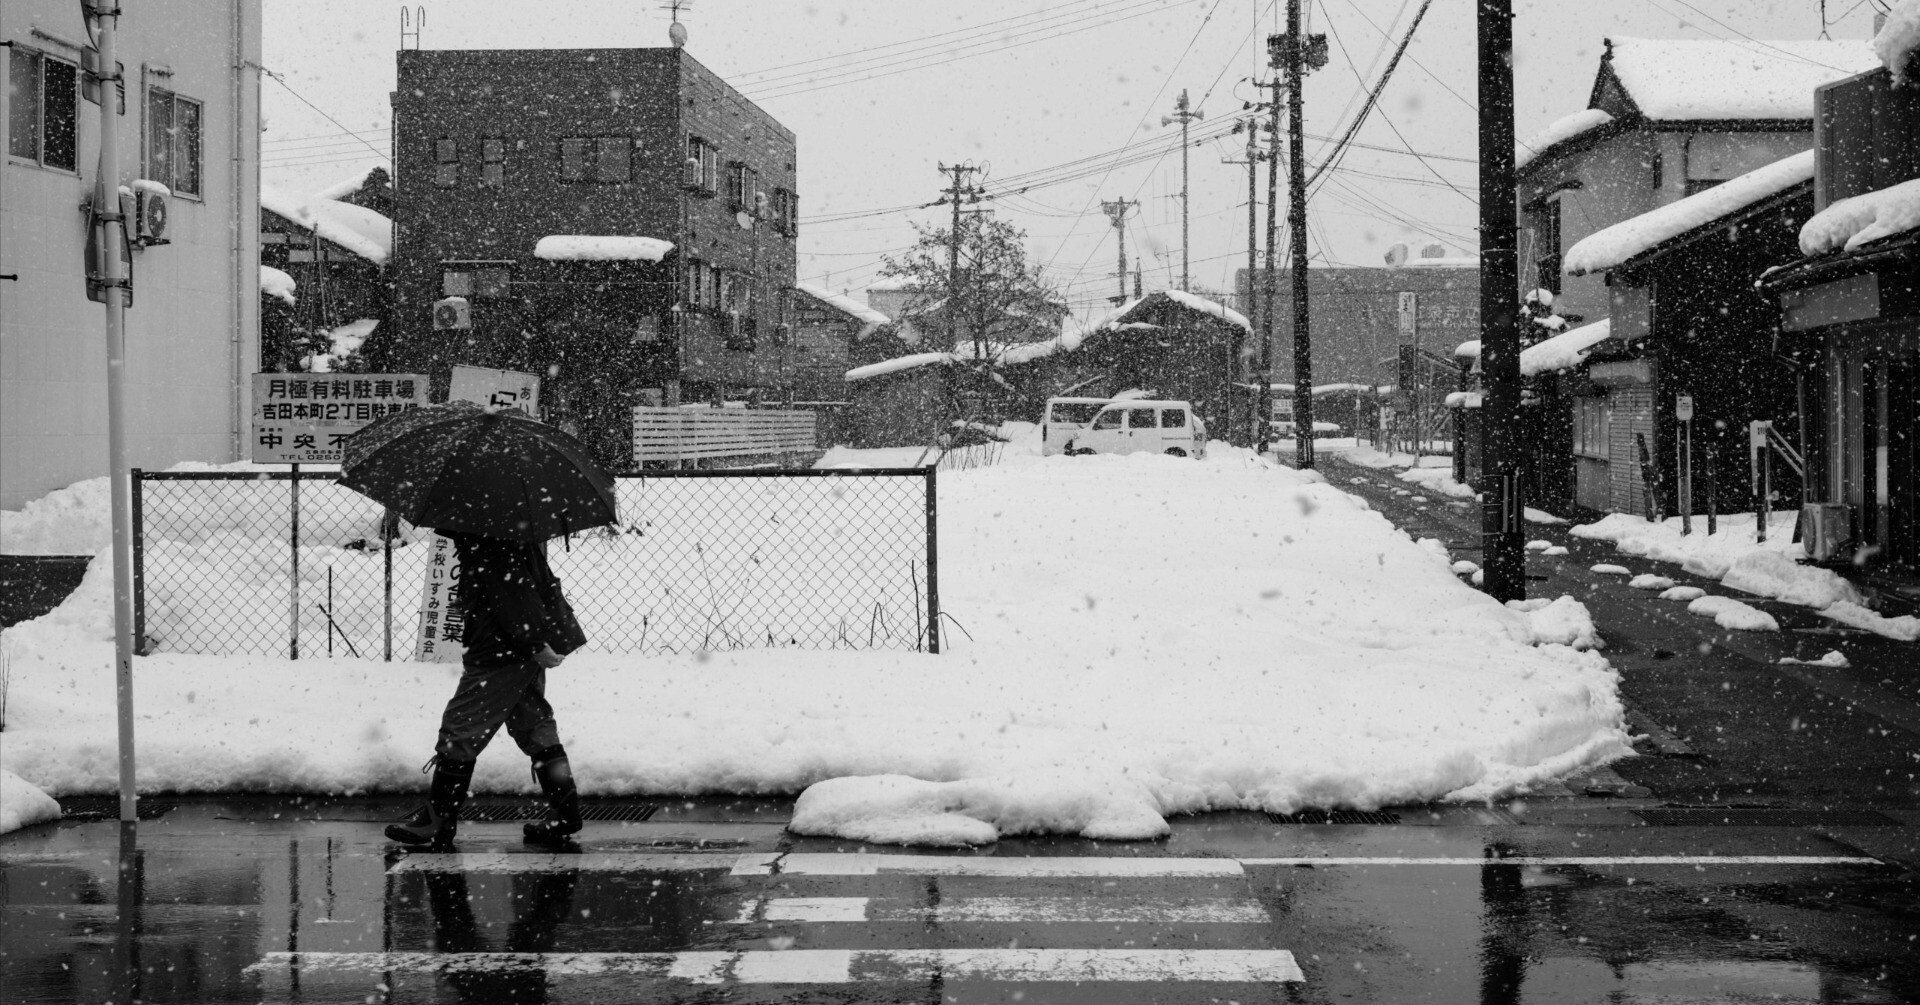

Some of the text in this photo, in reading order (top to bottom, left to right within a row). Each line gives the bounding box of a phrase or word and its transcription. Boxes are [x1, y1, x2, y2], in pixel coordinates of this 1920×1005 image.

[268, 379, 415, 400] 月極有料駐車場
